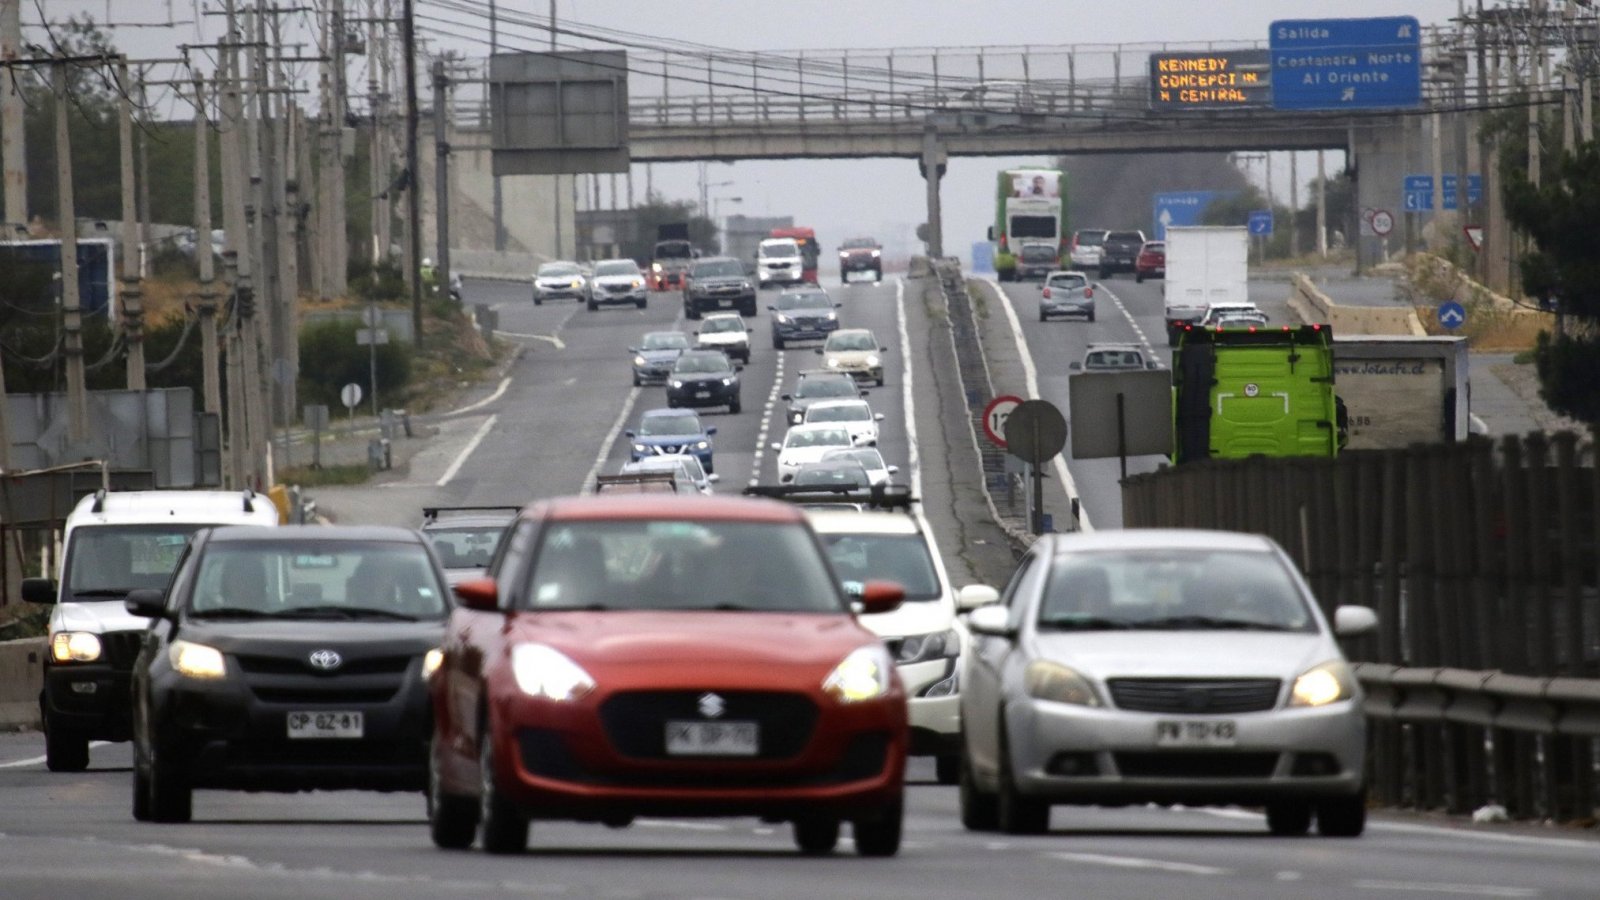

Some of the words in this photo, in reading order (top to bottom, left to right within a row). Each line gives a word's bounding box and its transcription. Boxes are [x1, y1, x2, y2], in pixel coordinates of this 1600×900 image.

[1277, 27, 1330, 39] Salida
[1159, 58, 1228, 72] KENNEDY
[1277, 55, 1357, 68] Costanera
[1368, 53, 1412, 65] Norte
[1303, 72, 1320, 84] Al
[1328, 71, 1390, 84] Oriente
